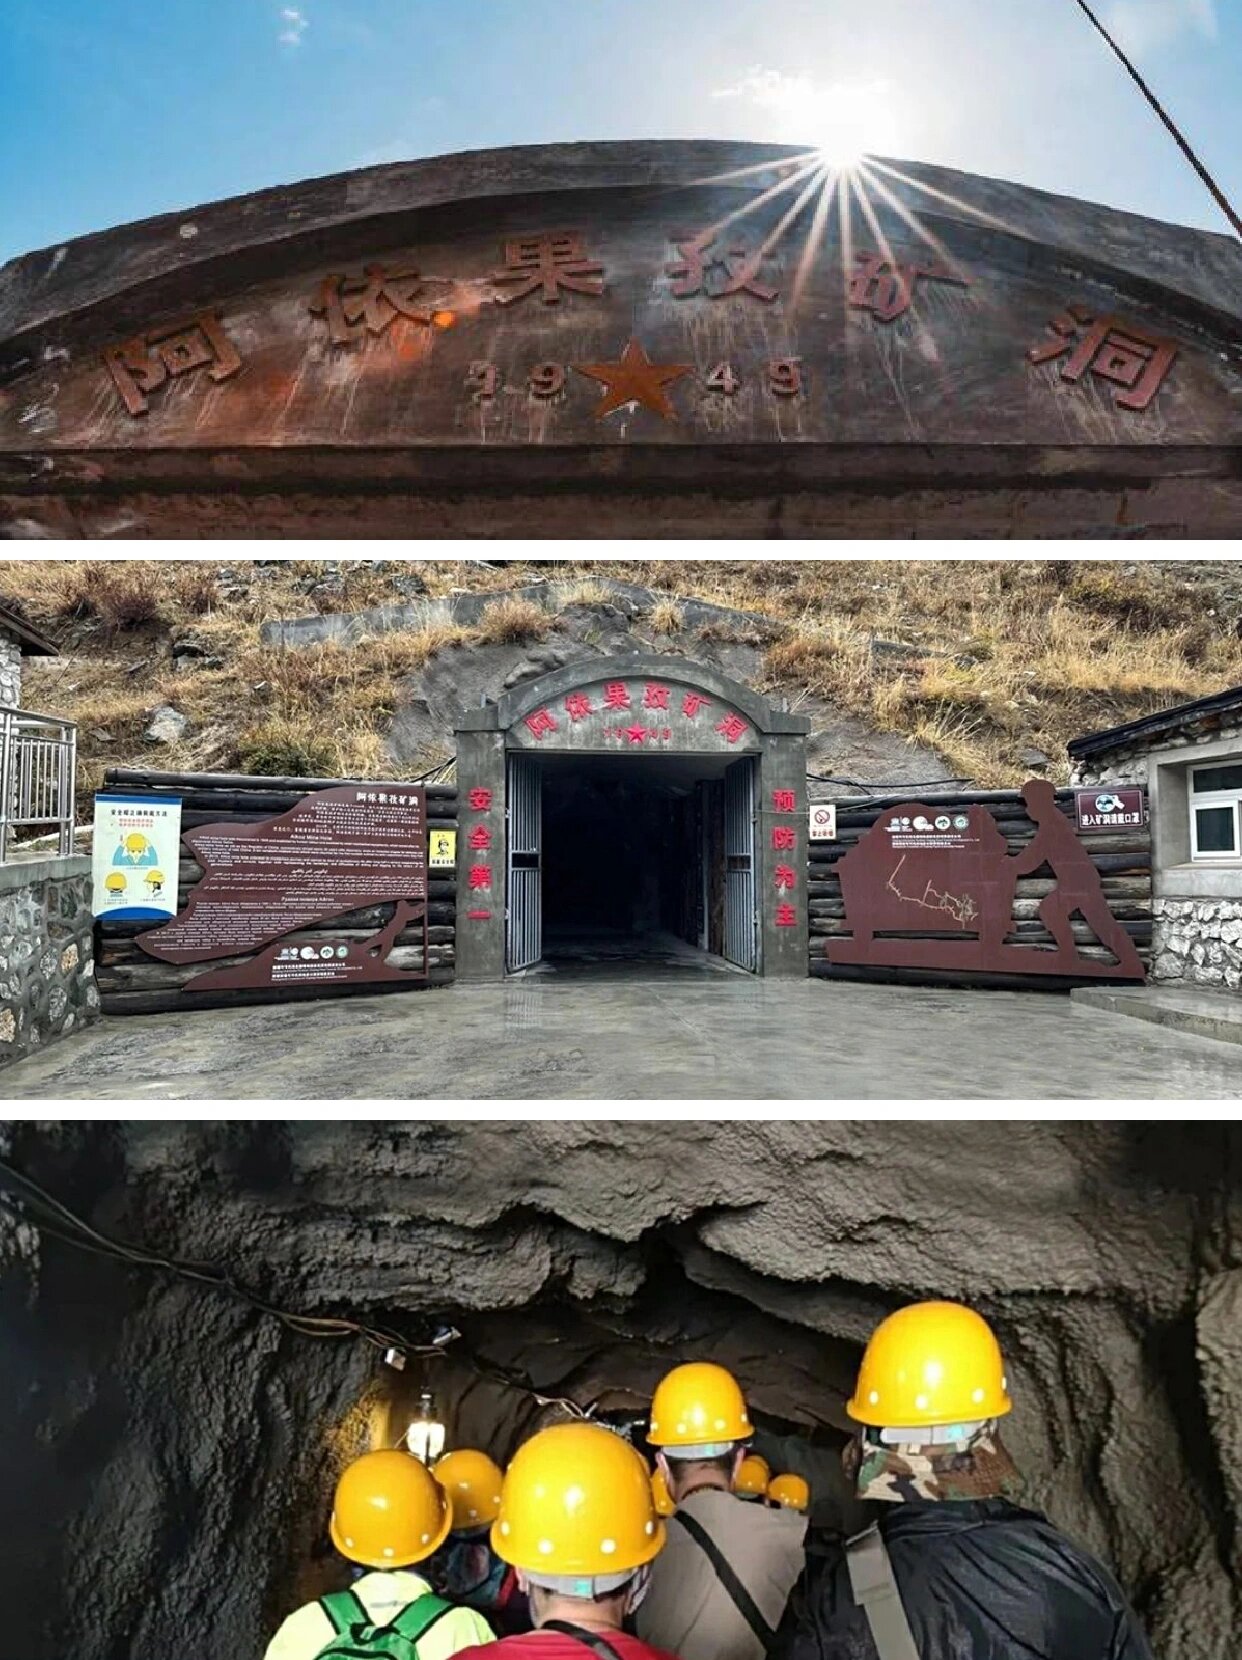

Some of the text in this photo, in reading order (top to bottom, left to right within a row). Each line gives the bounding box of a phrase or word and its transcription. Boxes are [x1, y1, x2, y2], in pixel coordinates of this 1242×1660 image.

[100, 231, 1179, 418] 阿依果孜矿洞
[465, 357, 801, 400] 19 49
[524, 680, 749, 744] 阿依果孜矿洞
[467, 786, 493, 920] 安全第一
[772, 788, 797, 927] 预防为主
